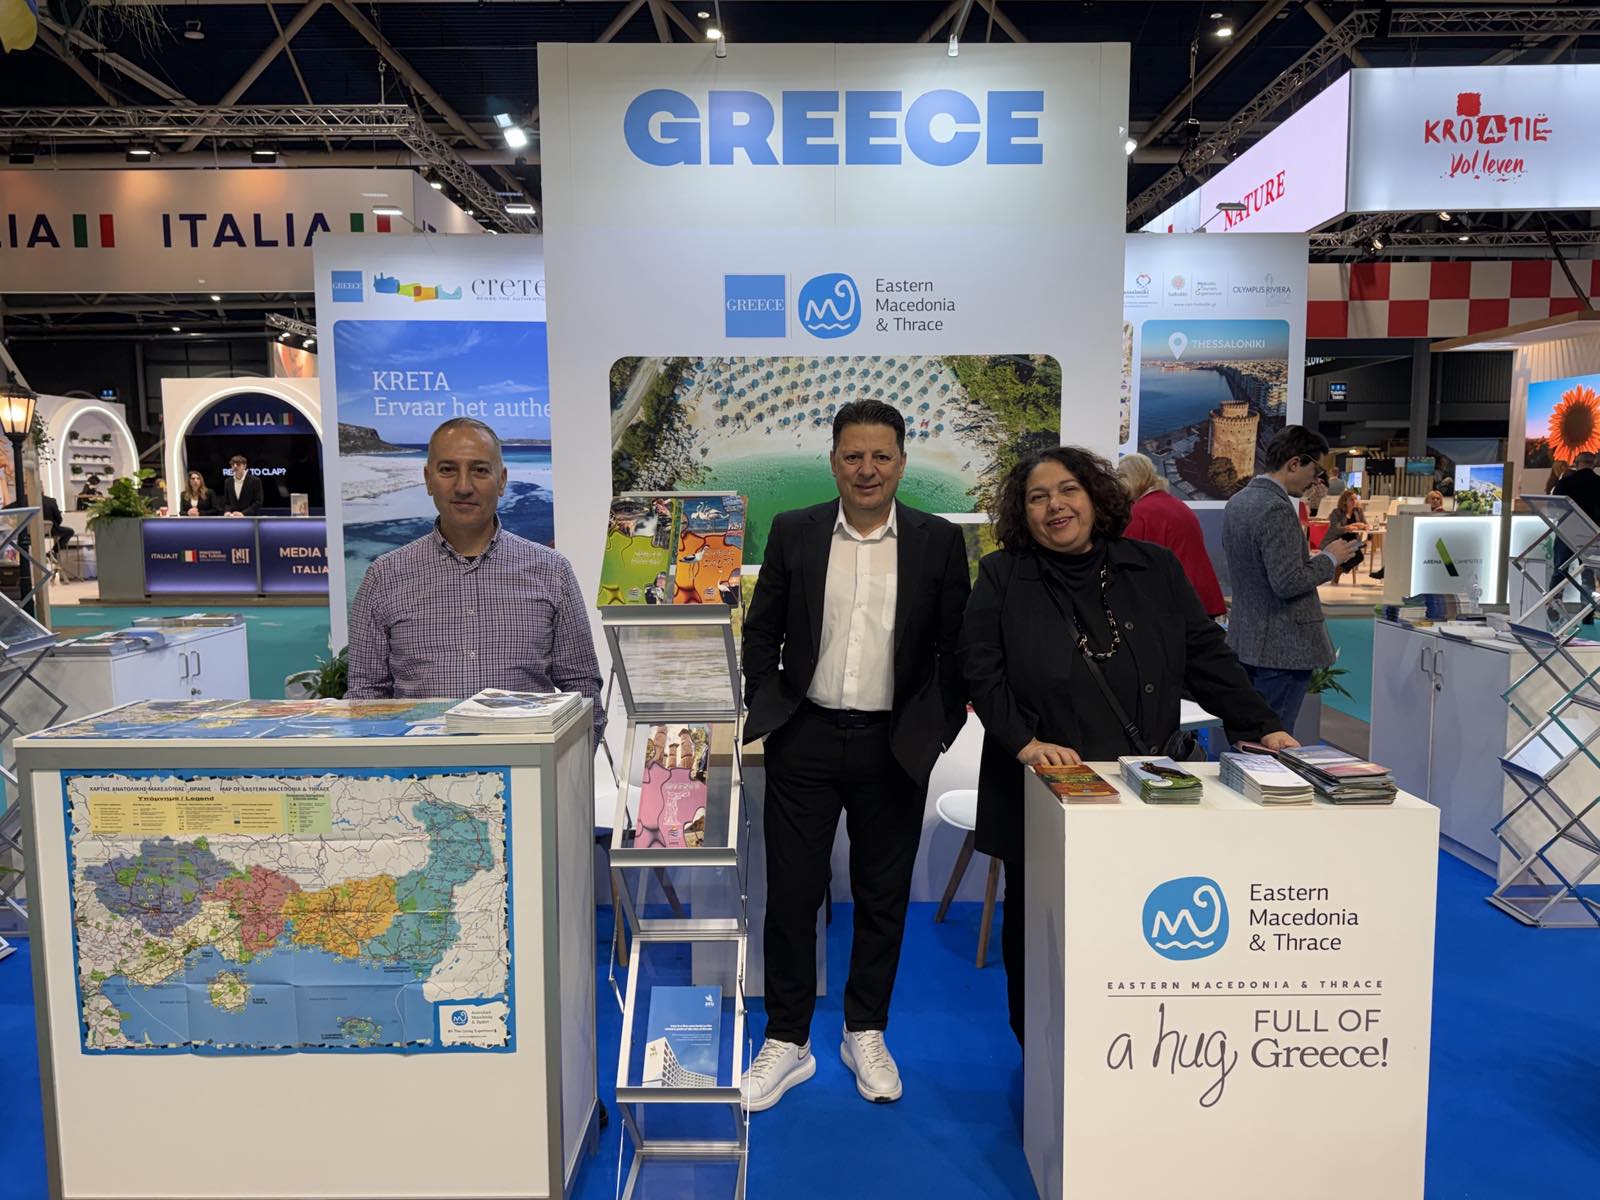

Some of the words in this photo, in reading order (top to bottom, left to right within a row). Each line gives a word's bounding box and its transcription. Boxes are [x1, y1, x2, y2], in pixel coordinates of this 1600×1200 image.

[623, 88, 1045, 167] GREECE
[1424, 113, 1552, 144] KROATIË
[1450, 149, 1479, 178] Vol
[1483, 149, 1525, 174] leven
[1224, 170, 1286, 231] NATURE
[875, 278, 933, 293] Eastern
[726, 299, 785, 312] GREECE
[875, 298, 956, 312] Macedonia
[875, 318, 888, 331] &
[893, 317, 944, 331] Thrace
[1192, 339, 1265, 349] THESSALONIKI
[373, 371, 450, 391] KRETA
[373, 397, 446, 417] Ervaar
[452, 397, 488, 417] het
[213, 413, 275, 426] ITALIA
[250, 468, 261, 476] TO
[261, 467, 287, 476] CLAP?
[280, 547, 322, 558] MEDIA
[1250, 883, 1329, 901] Eastern
[1249, 908, 1359, 926] Macedonia
[1249, 934, 1266, 952] &
[1273, 933, 1342, 951] Thrace
[1107, 981, 1180, 990] EASTERN
[1191, 981, 1290, 990] MACEDONIA
[1301, 980, 1309, 989] &
[1320, 980, 1383, 989] THRACE
[1254, 1009, 1329, 1033] FULL
[1338, 1008, 1382, 1032] OF
[1107, 1032, 1133, 1070] a
[1153, 1002, 1238, 1108] hug
[1251, 1037, 1389, 1068] Greece!
